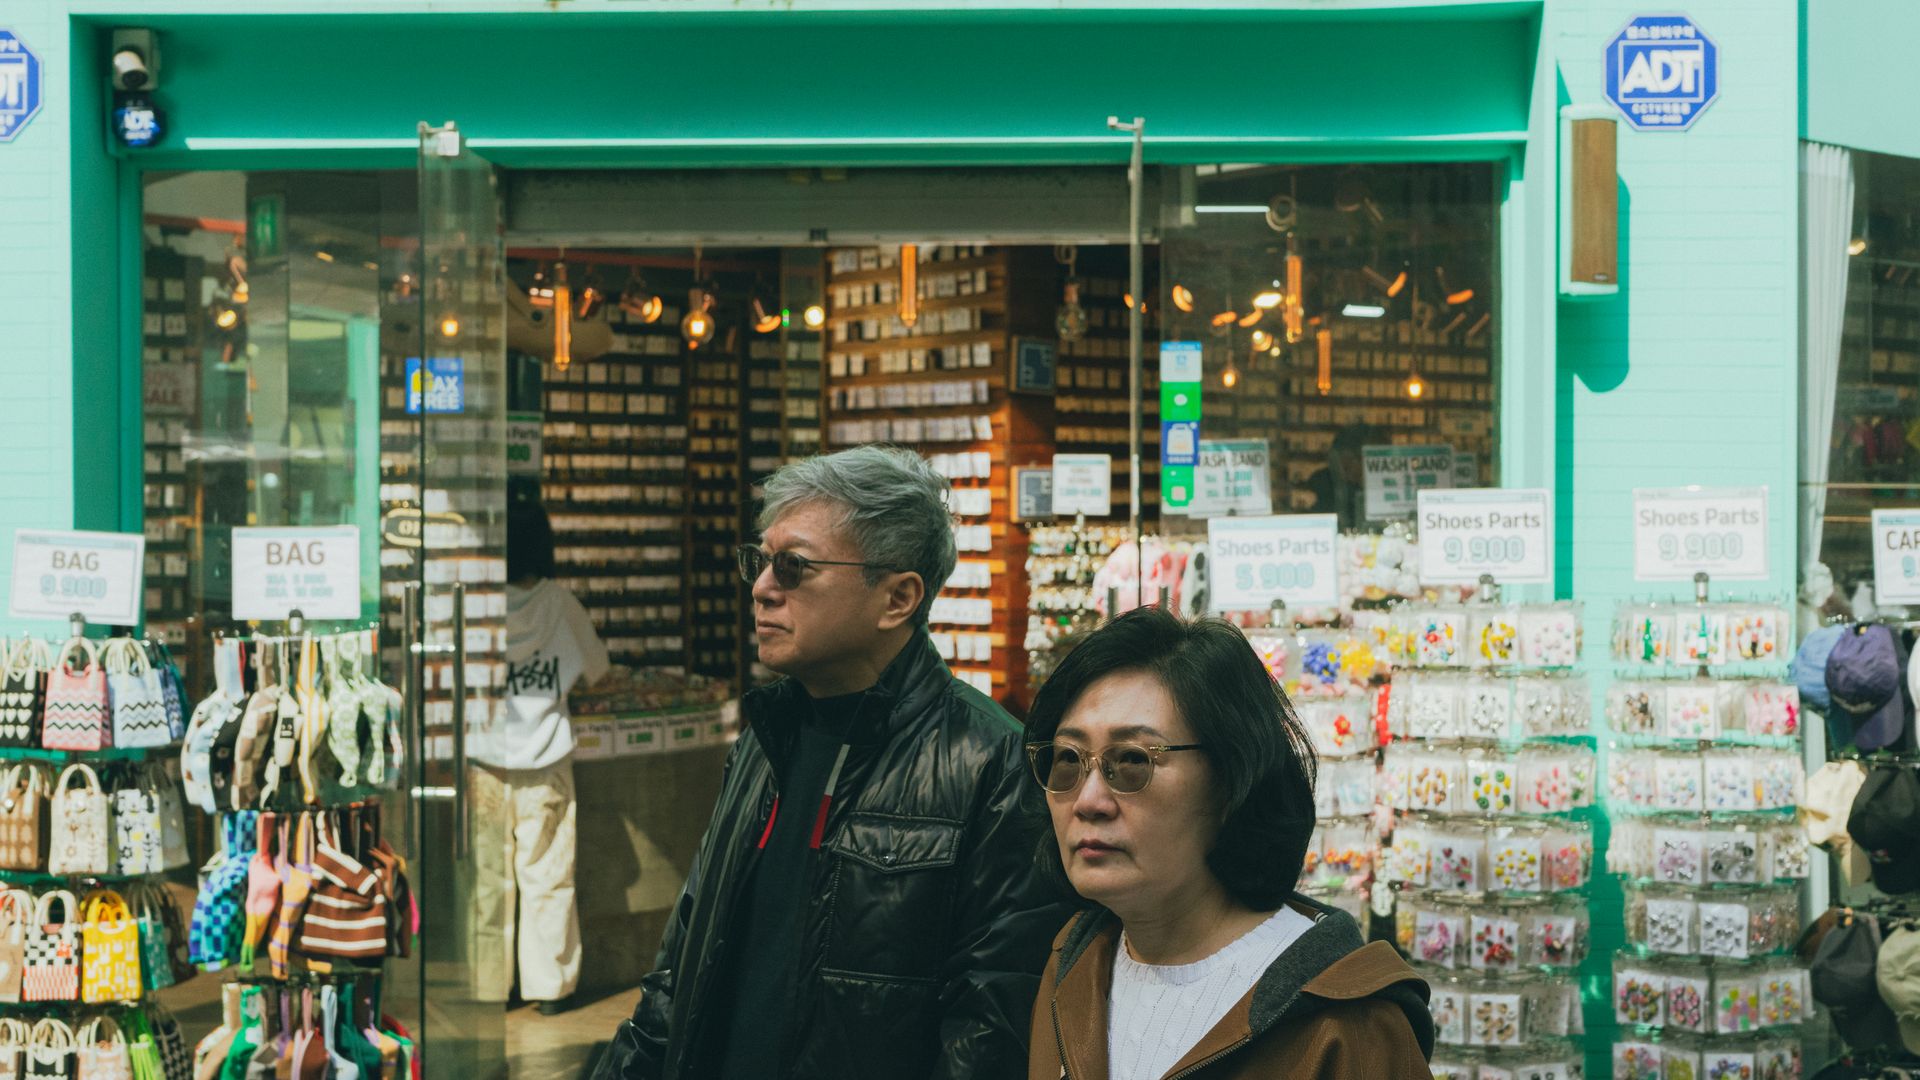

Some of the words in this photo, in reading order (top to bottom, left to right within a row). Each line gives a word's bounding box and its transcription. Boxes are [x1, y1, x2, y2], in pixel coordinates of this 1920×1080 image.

[1621, 49, 1703, 93] ADT
[1199, 453, 1227, 467] ASH
[1366, 457, 1408, 472] WASH
[1425, 512, 1483, 530] Shoes
[1489, 511, 1541, 529] Parts
[1640, 509, 1699, 526] Shoes
[1705, 507, 1760, 525] Parts
[265, 541, 325, 566] BAG
[1217, 539, 1274, 557] Shoes
[1279, 537, 1330, 555] Parts
[51, 549, 100, 572] BAG
